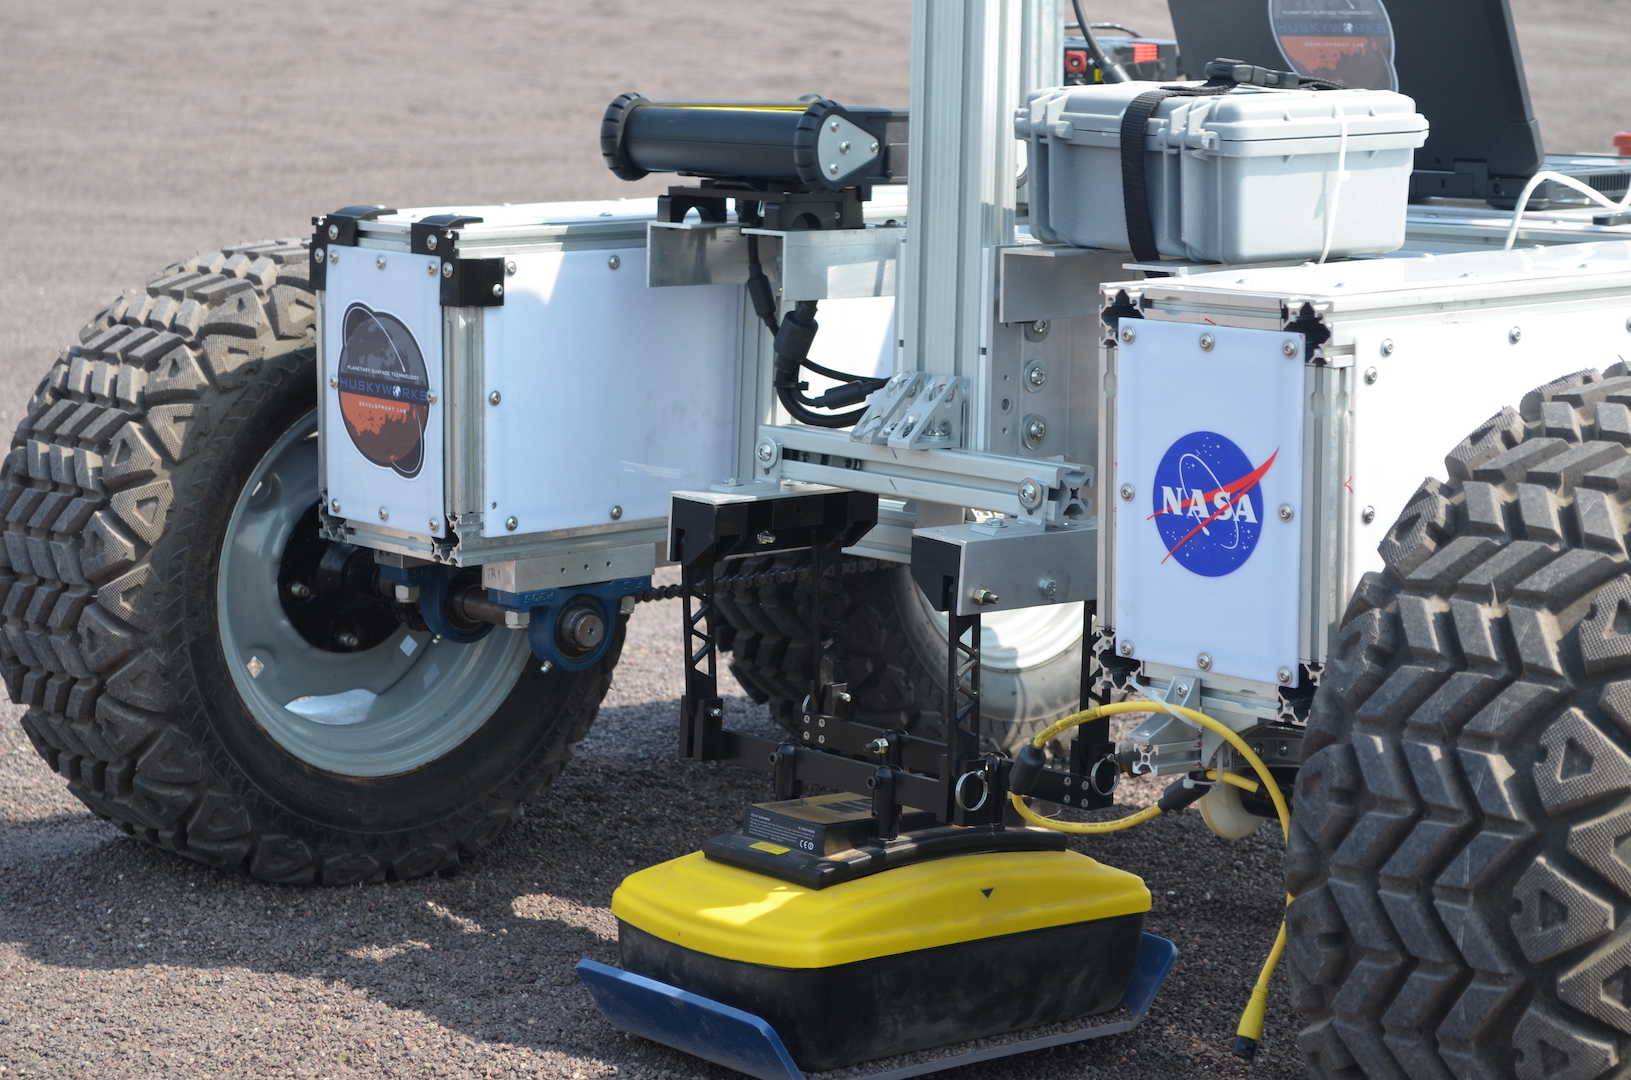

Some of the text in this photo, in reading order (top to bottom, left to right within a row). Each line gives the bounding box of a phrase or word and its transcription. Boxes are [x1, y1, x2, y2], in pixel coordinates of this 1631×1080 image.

[1276, 22, 1387, 34] HUSKYWORKS
[347, 364, 419, 381] PLANETARY SURFACE TECHNOLOGY
[339, 377, 428, 402] HUSKYWORKS
[358, 401, 407, 414] DEVELOPMENT LAB
[1161, 485, 1258, 524] NASA
